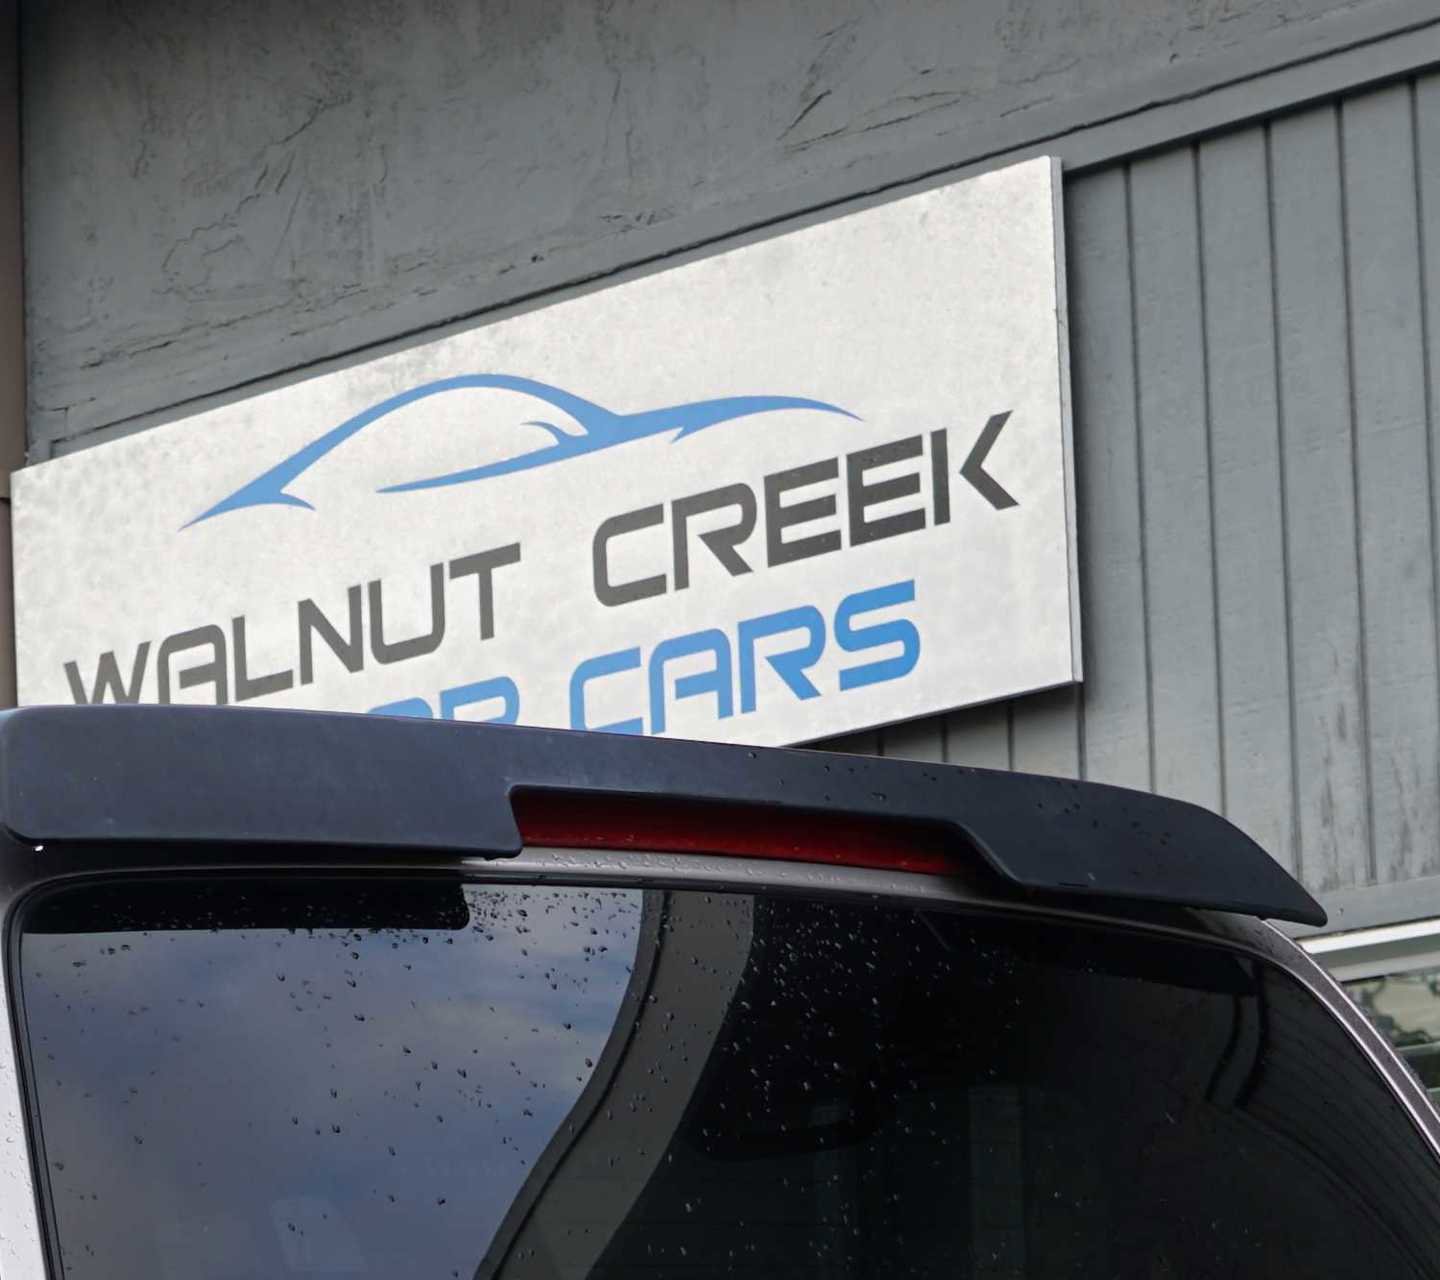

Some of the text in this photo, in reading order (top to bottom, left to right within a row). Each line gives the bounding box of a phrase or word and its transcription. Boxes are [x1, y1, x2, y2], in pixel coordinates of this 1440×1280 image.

[63, 410, 1020, 706] WALNUT CREEK
[569, 579, 921, 735] CARS
